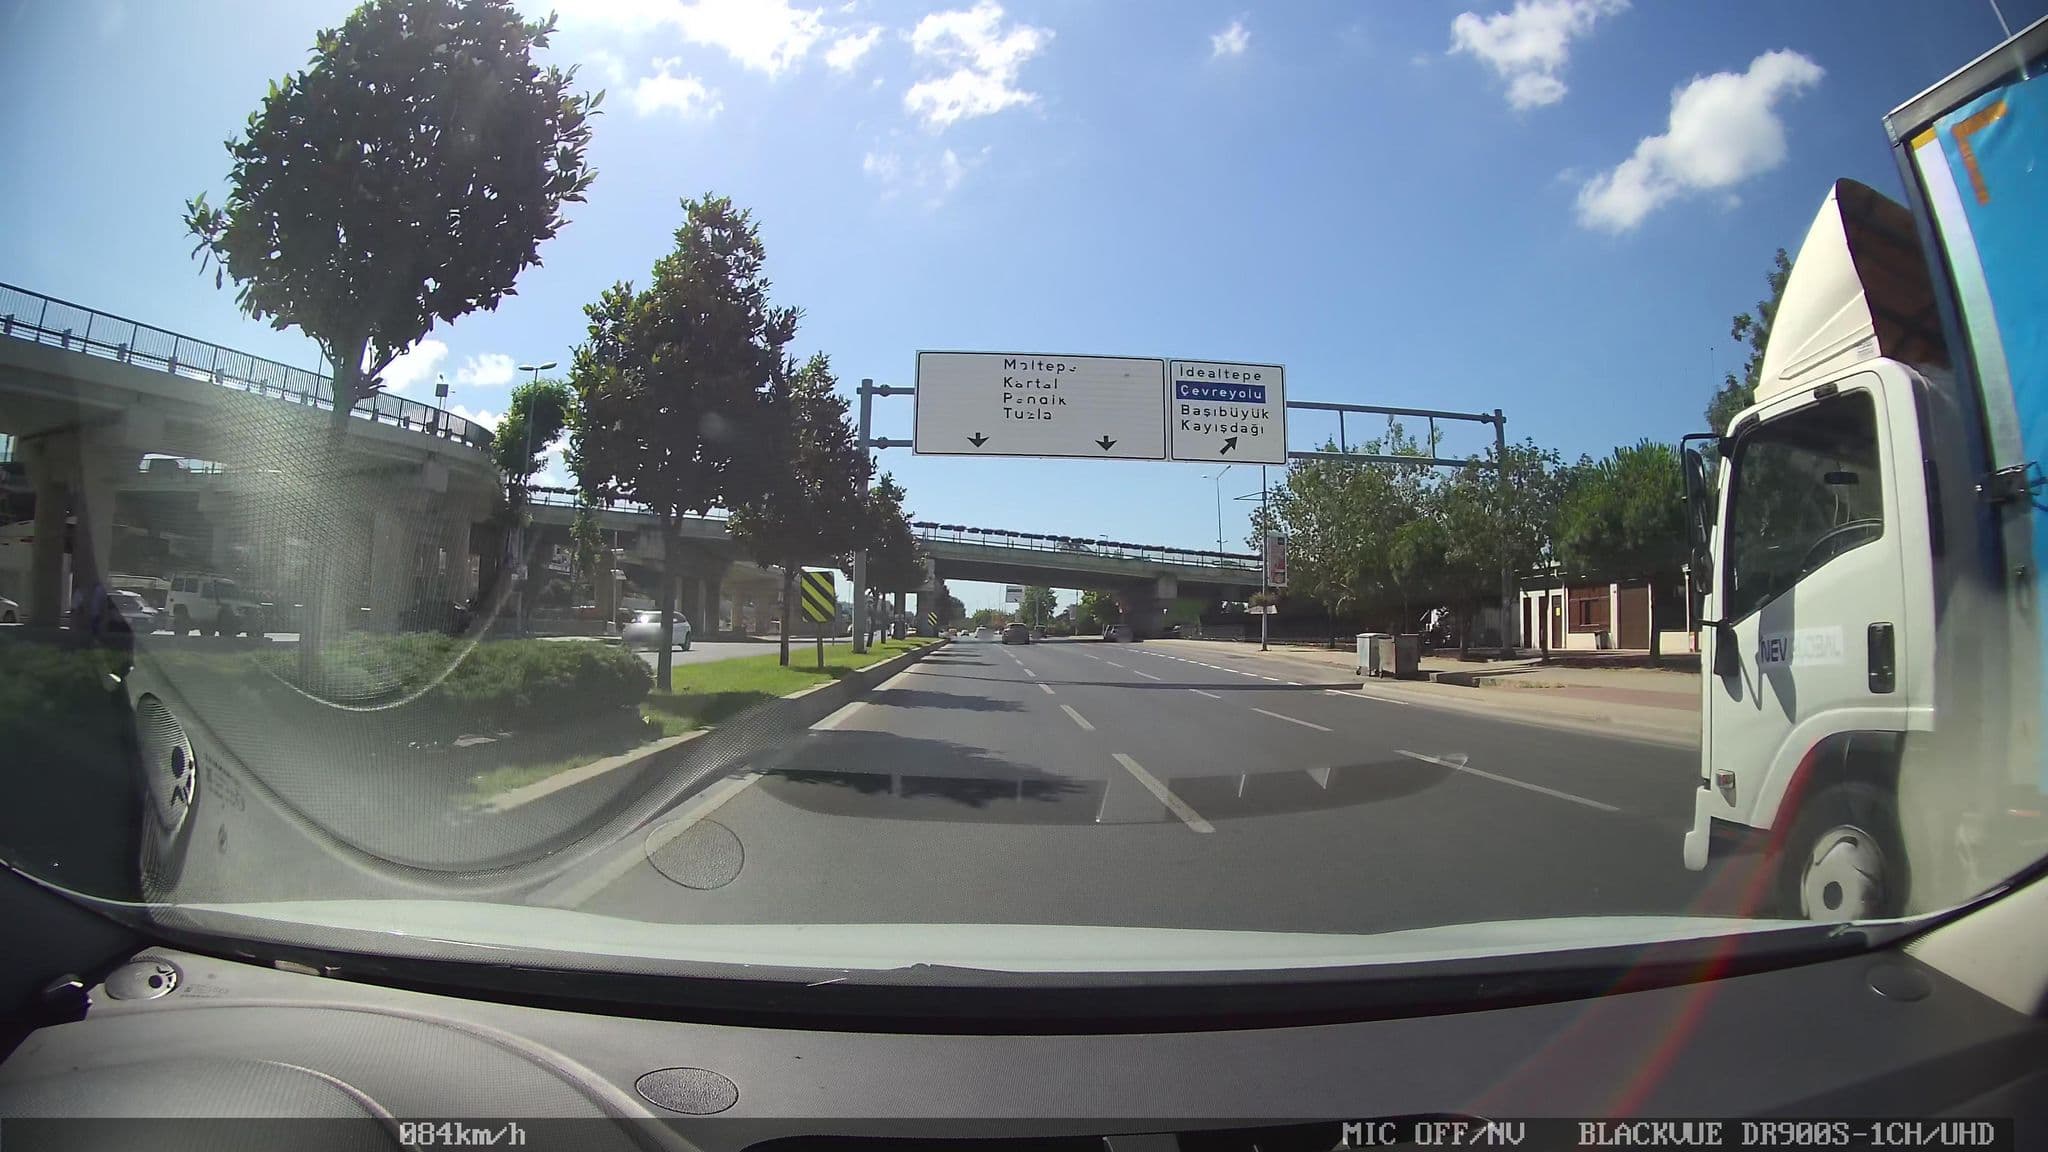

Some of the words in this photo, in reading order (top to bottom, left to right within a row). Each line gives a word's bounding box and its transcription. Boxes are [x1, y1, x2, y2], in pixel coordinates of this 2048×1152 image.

[1180, 363, 1262, 383] İdealtepe
[1180, 384, 1262, 400] Çevreyolu
[1003, 407, 1052, 420] Tuzla
[1181, 404, 1269, 420] Başıbüyük
[1181, 419, 1264, 436] Kayışdağı
